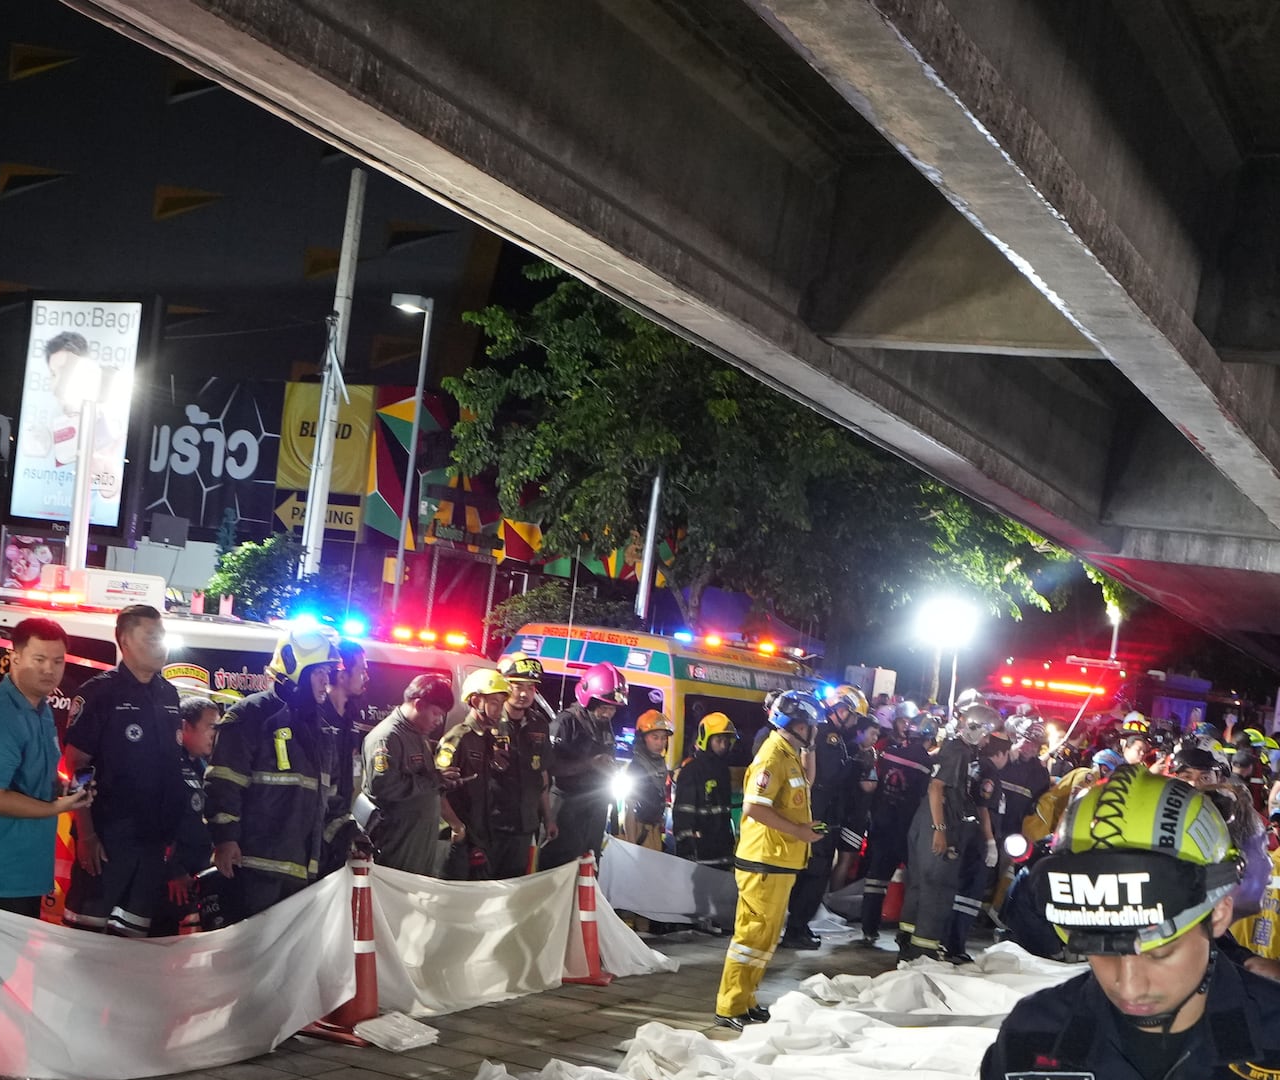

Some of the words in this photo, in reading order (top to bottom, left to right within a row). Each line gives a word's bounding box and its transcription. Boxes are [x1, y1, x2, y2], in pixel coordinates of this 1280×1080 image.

[299, 421, 352, 441] BLND
[291, 506, 353, 525] PAING
[704, 663, 751, 688] MERGENCY
[1047, 872, 1150, 905] EMT
